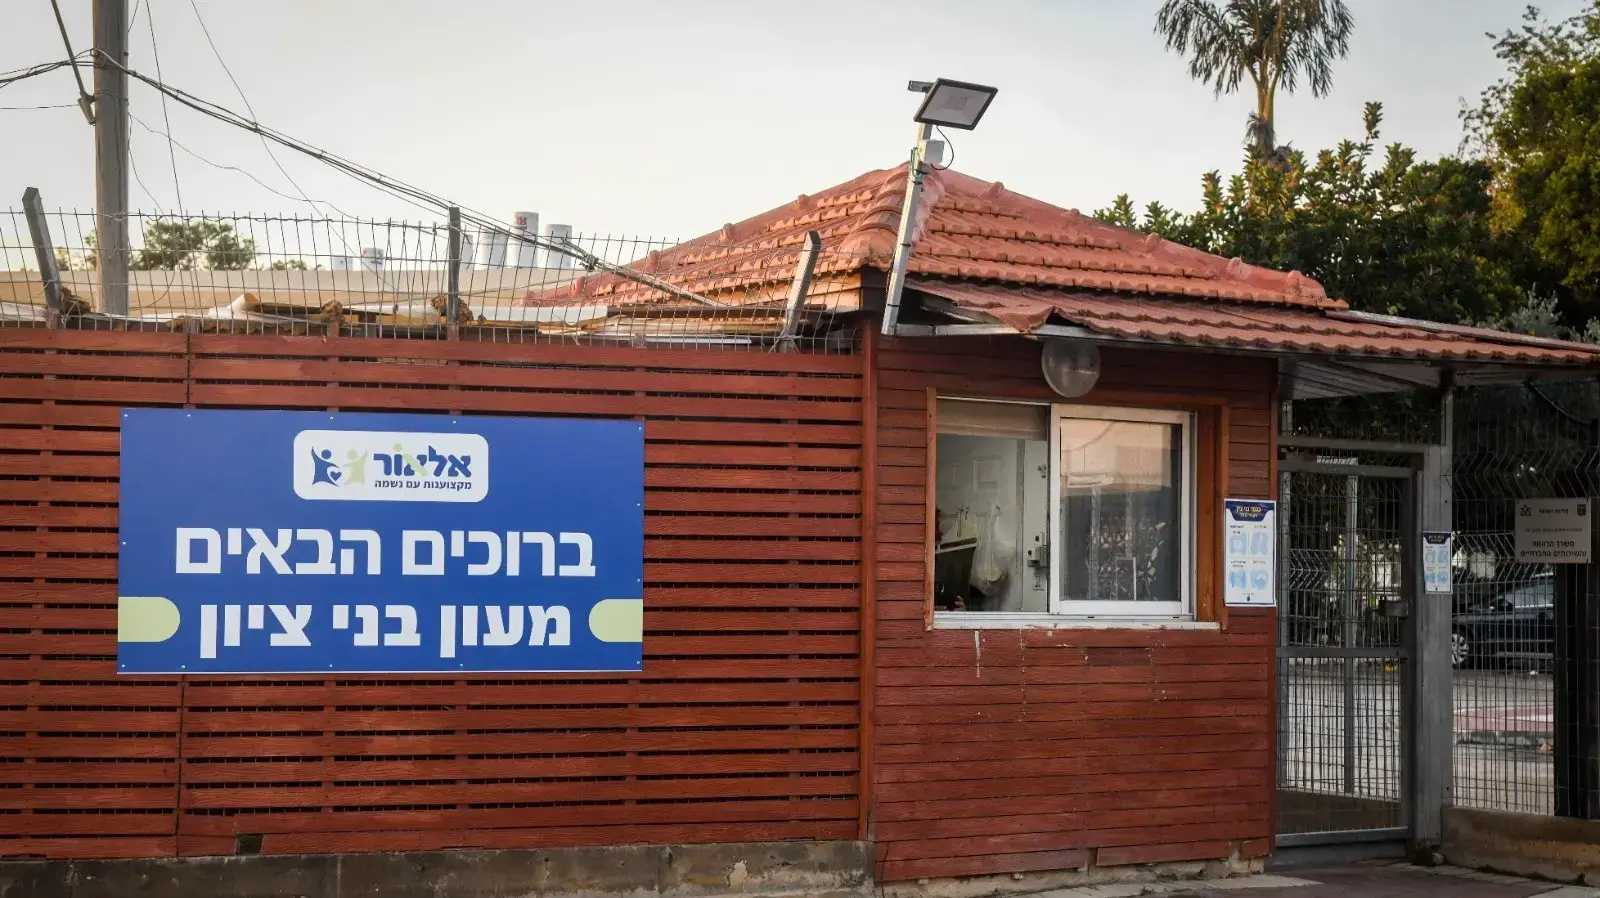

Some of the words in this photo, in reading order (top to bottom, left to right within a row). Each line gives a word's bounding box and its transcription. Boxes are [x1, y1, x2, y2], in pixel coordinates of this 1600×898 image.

[374, 479, 404, 489] נשמה
[405, 480, 421, 489] עם
[423, 480, 472, 492] מקצוענות
[175, 527, 381, 575] הבאים
[401, 530, 596, 577] ברוכים
[1556, 540, 1575, 548] משרד
[200, 604, 313, 659] ציון
[332, 604, 421, 647] בני
[439, 605, 571, 658] מעון
